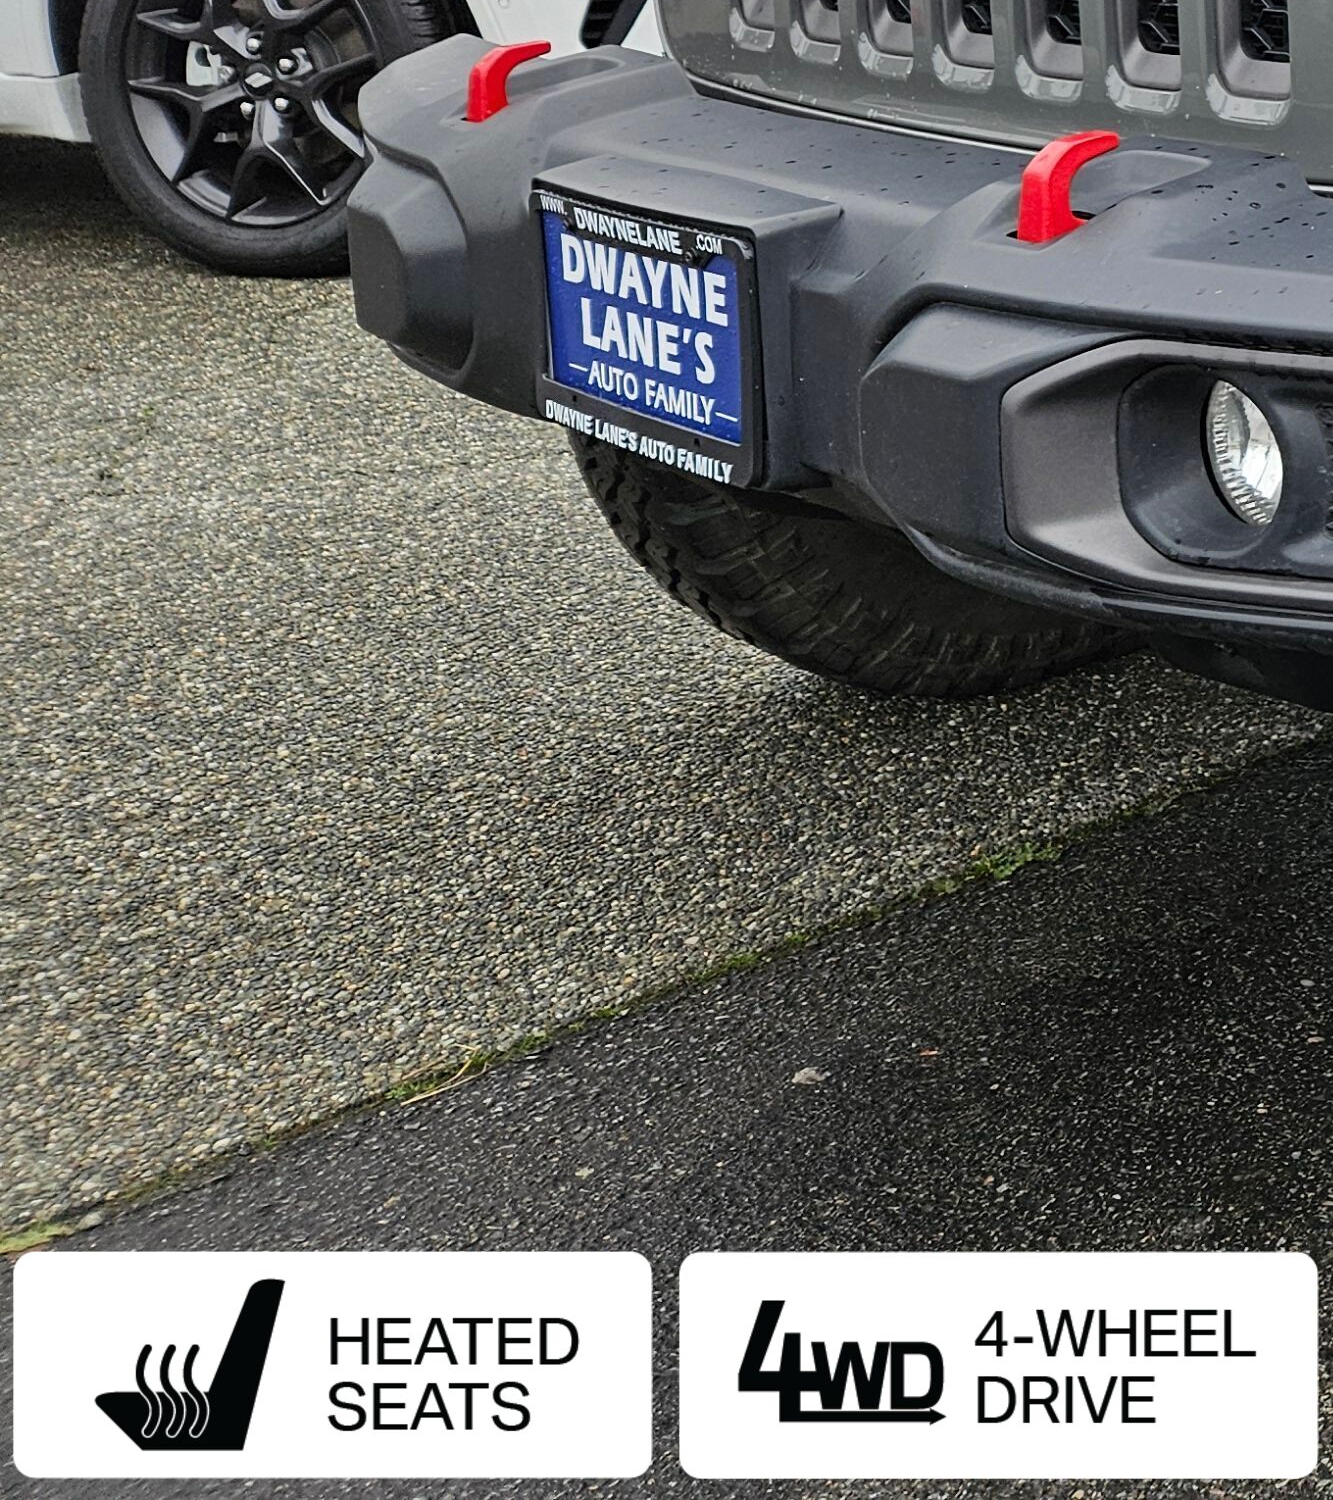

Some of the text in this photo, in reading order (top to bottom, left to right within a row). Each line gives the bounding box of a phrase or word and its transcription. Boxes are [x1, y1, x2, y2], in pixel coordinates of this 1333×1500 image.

[573, 206, 684, 256] DWAYNELANE
[695, 233, 723, 256] .COM
[560, 232, 729, 328] DWAYNE
[581, 296, 716, 385] LANE'S
[588, 360, 717, 426] AUTO FAMILY
[545, 399, 735, 485] DWAYNE LANE'S AUTO FAMILY
